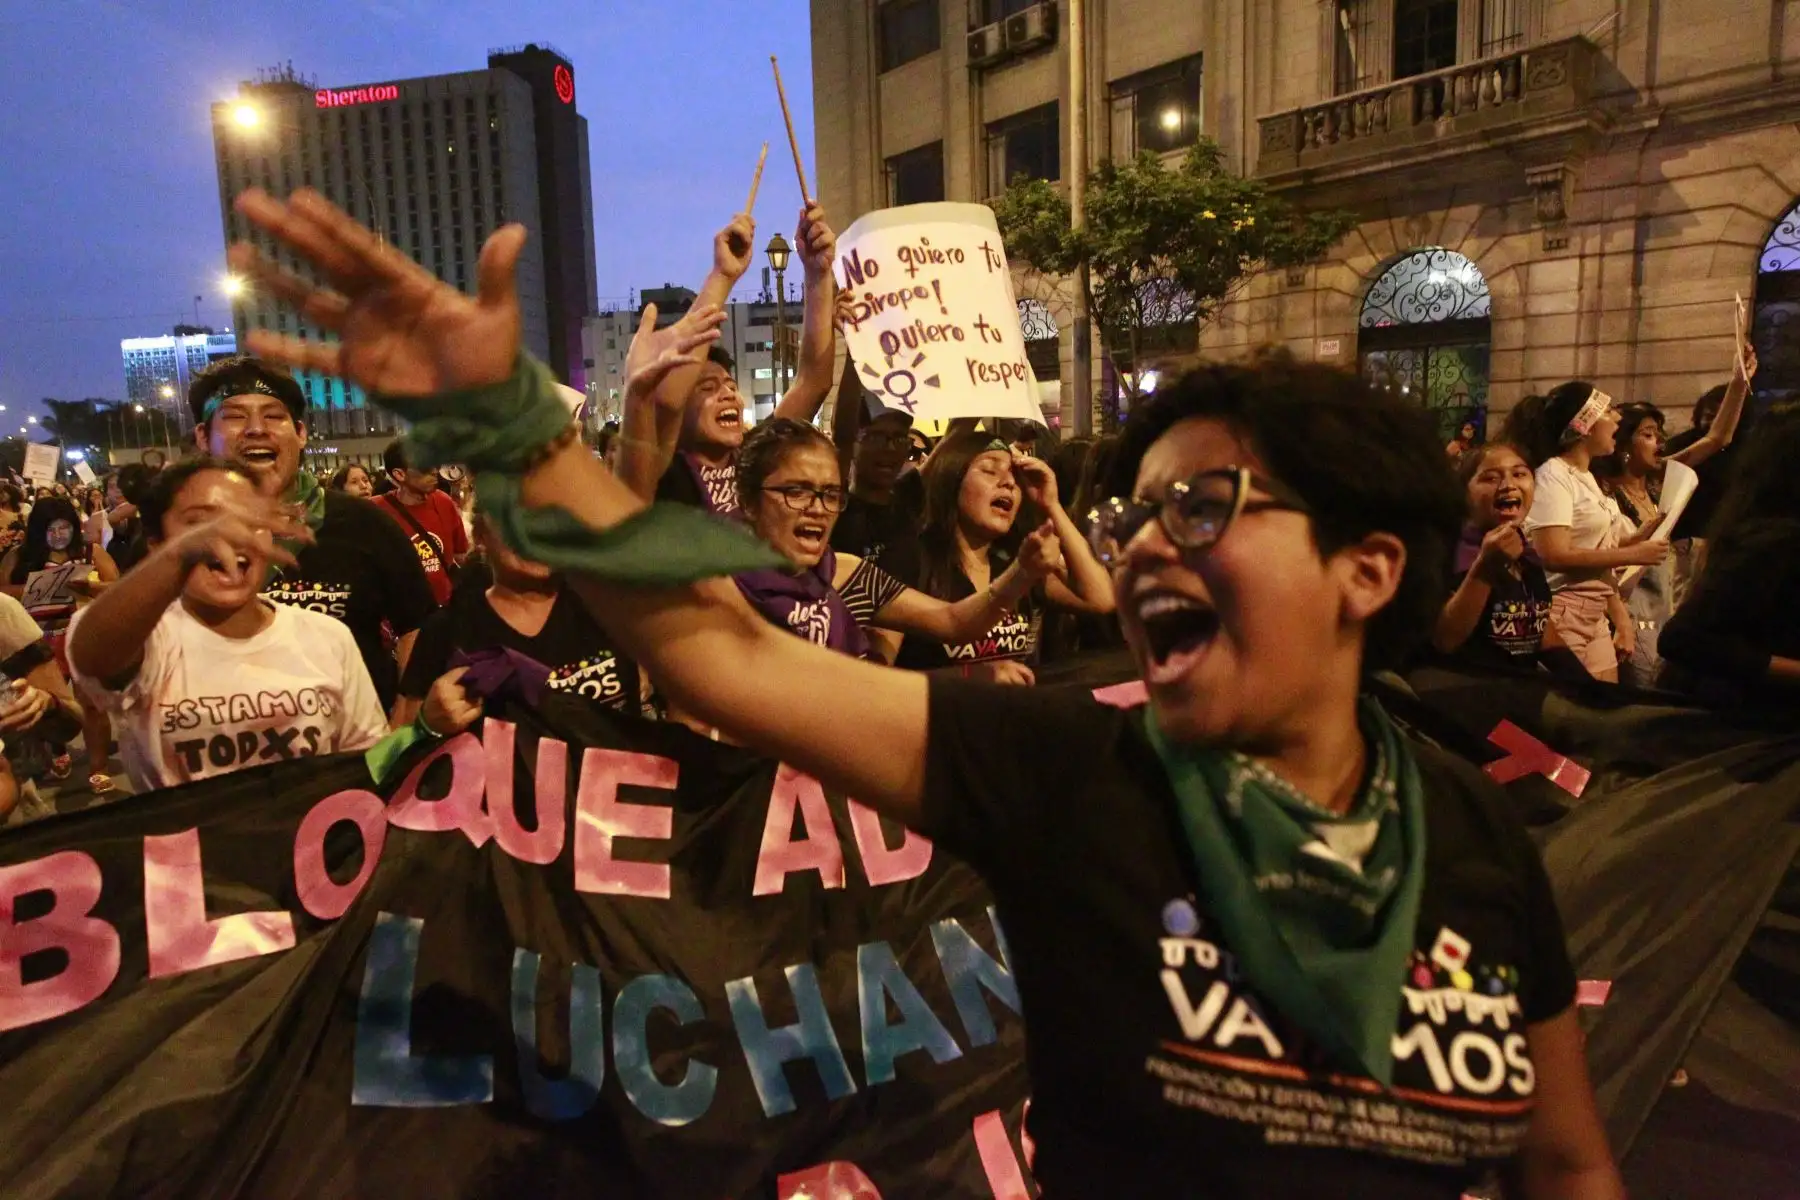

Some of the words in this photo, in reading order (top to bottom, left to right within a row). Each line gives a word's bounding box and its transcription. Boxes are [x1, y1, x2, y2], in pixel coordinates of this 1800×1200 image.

[315, 84, 398, 107] Sheraton
[842, 247, 879, 292] No
[897, 236, 965, 278] quiero
[977, 240, 1001, 273] tu
[973, 312, 1003, 344] tu
[159, 687, 332, 735] ESTAMOS
[175, 725, 322, 774] TODXS
[0, 716, 681, 1033] BLOQUE
